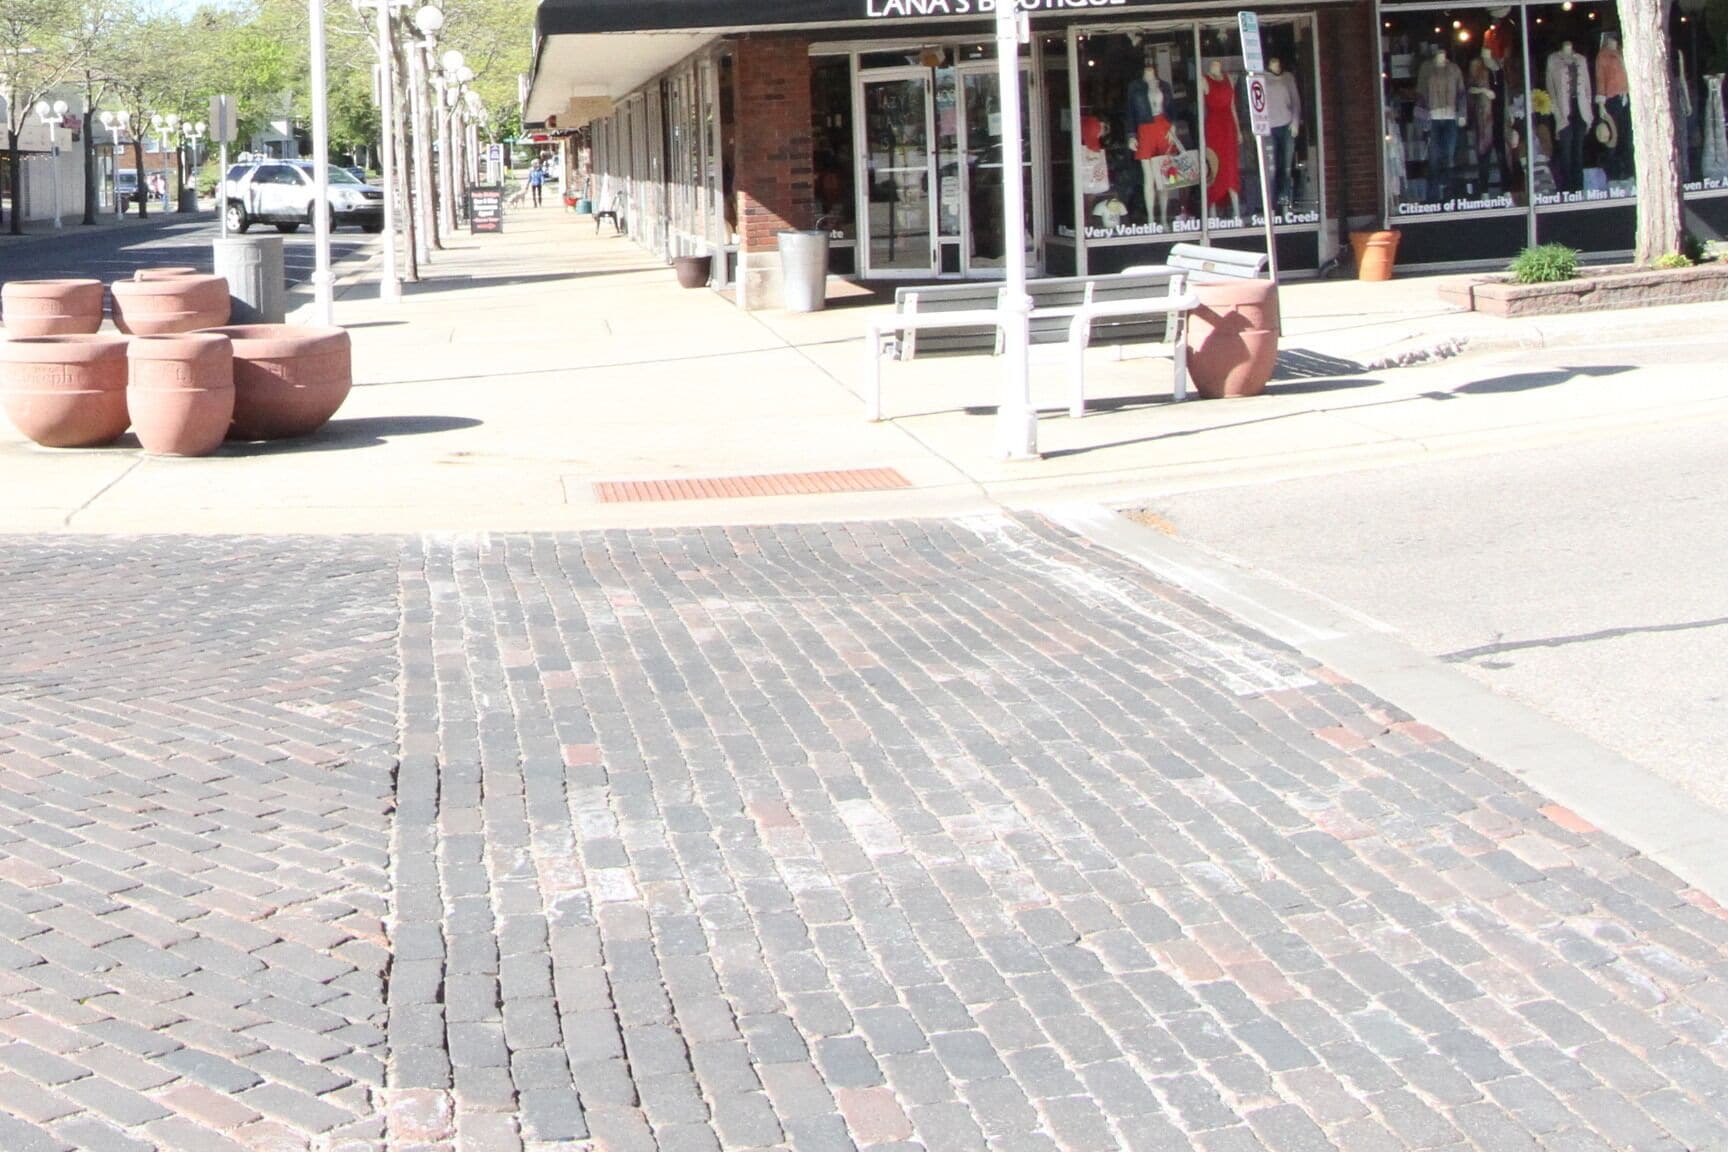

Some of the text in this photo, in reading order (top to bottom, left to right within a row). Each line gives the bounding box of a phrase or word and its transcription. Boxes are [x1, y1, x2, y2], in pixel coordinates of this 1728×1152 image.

[1398, 195, 1513, 214] Citizens of Humanity
[1534, 191, 1561, 205] Hard
[1561, 190, 1583, 203] Tail
[1587, 188, 1608, 200] Miss
[1251, 213, 1282, 227] Swn
[1284, 210, 1319, 223] Creek
[1084, 226, 1113, 239] Very
[1115, 221, 1164, 236] Volatile
[1172, 218, 1201, 232] EMU
